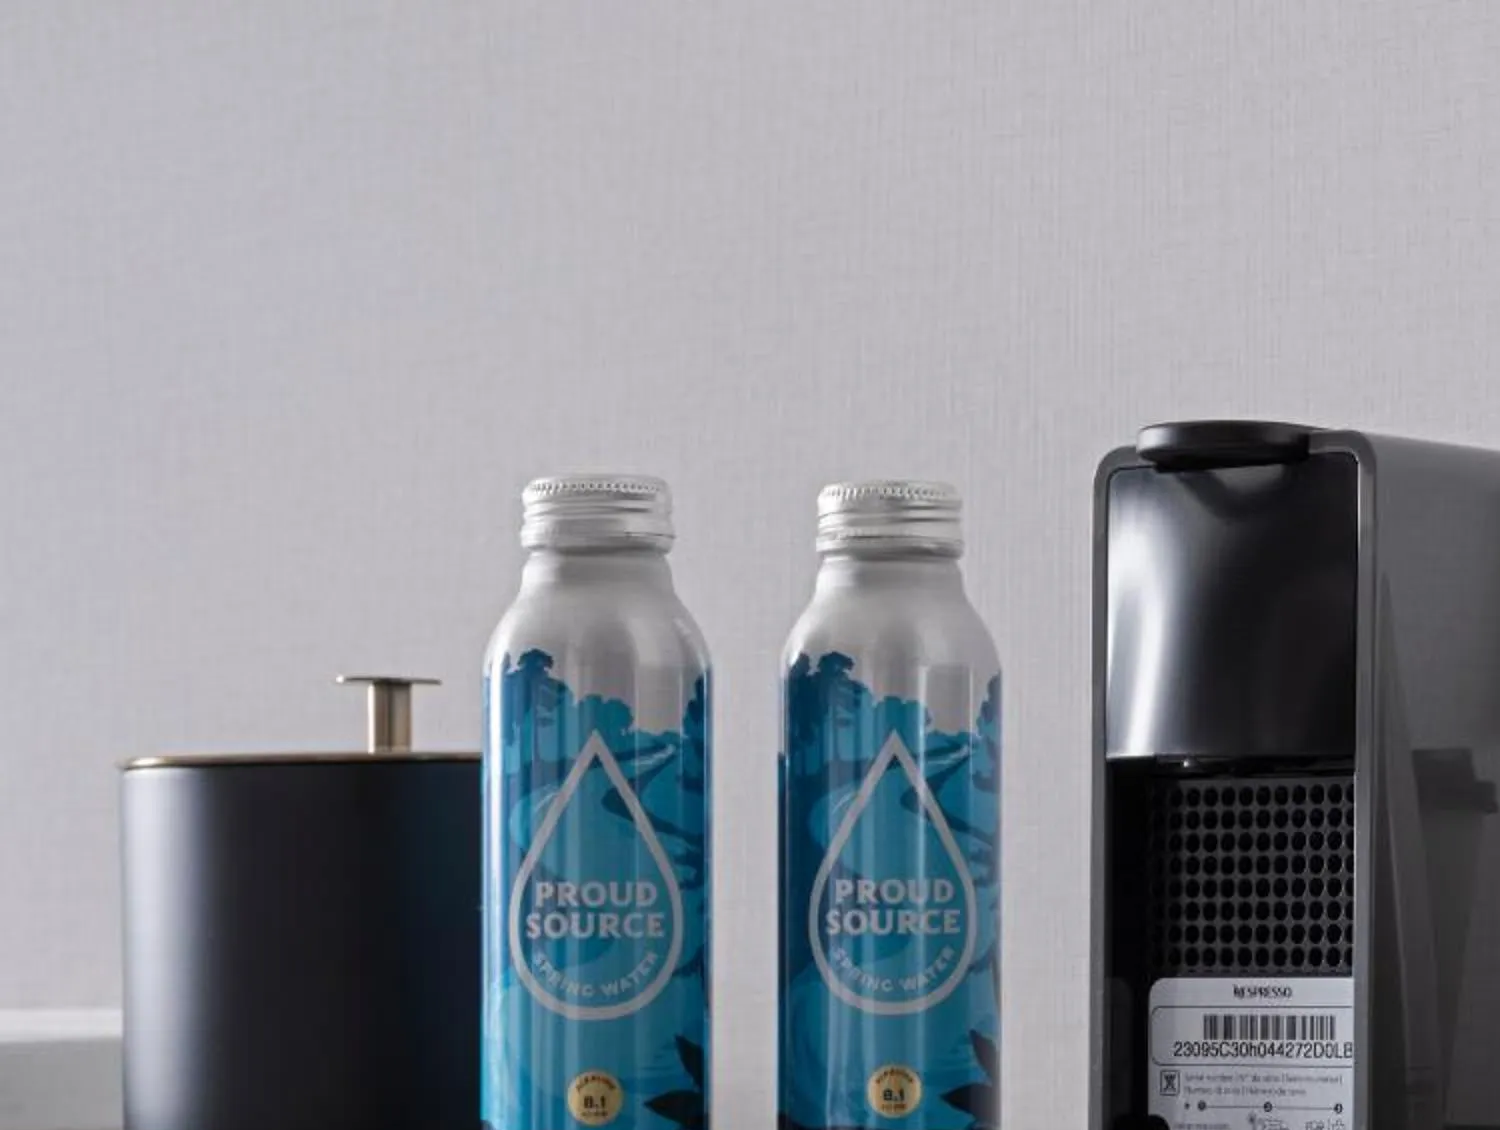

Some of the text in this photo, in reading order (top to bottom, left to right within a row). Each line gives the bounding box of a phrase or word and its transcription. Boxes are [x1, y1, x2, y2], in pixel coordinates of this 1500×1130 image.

[535, 881, 658, 907] PROUD
[835, 879, 955, 905] PROUD
[526, 911, 665, 939] SOURCE
[826, 908, 961, 936] SOURCE
[533, 951, 658, 998] SPRING WATER
[898, 946, 955, 993] WATER
